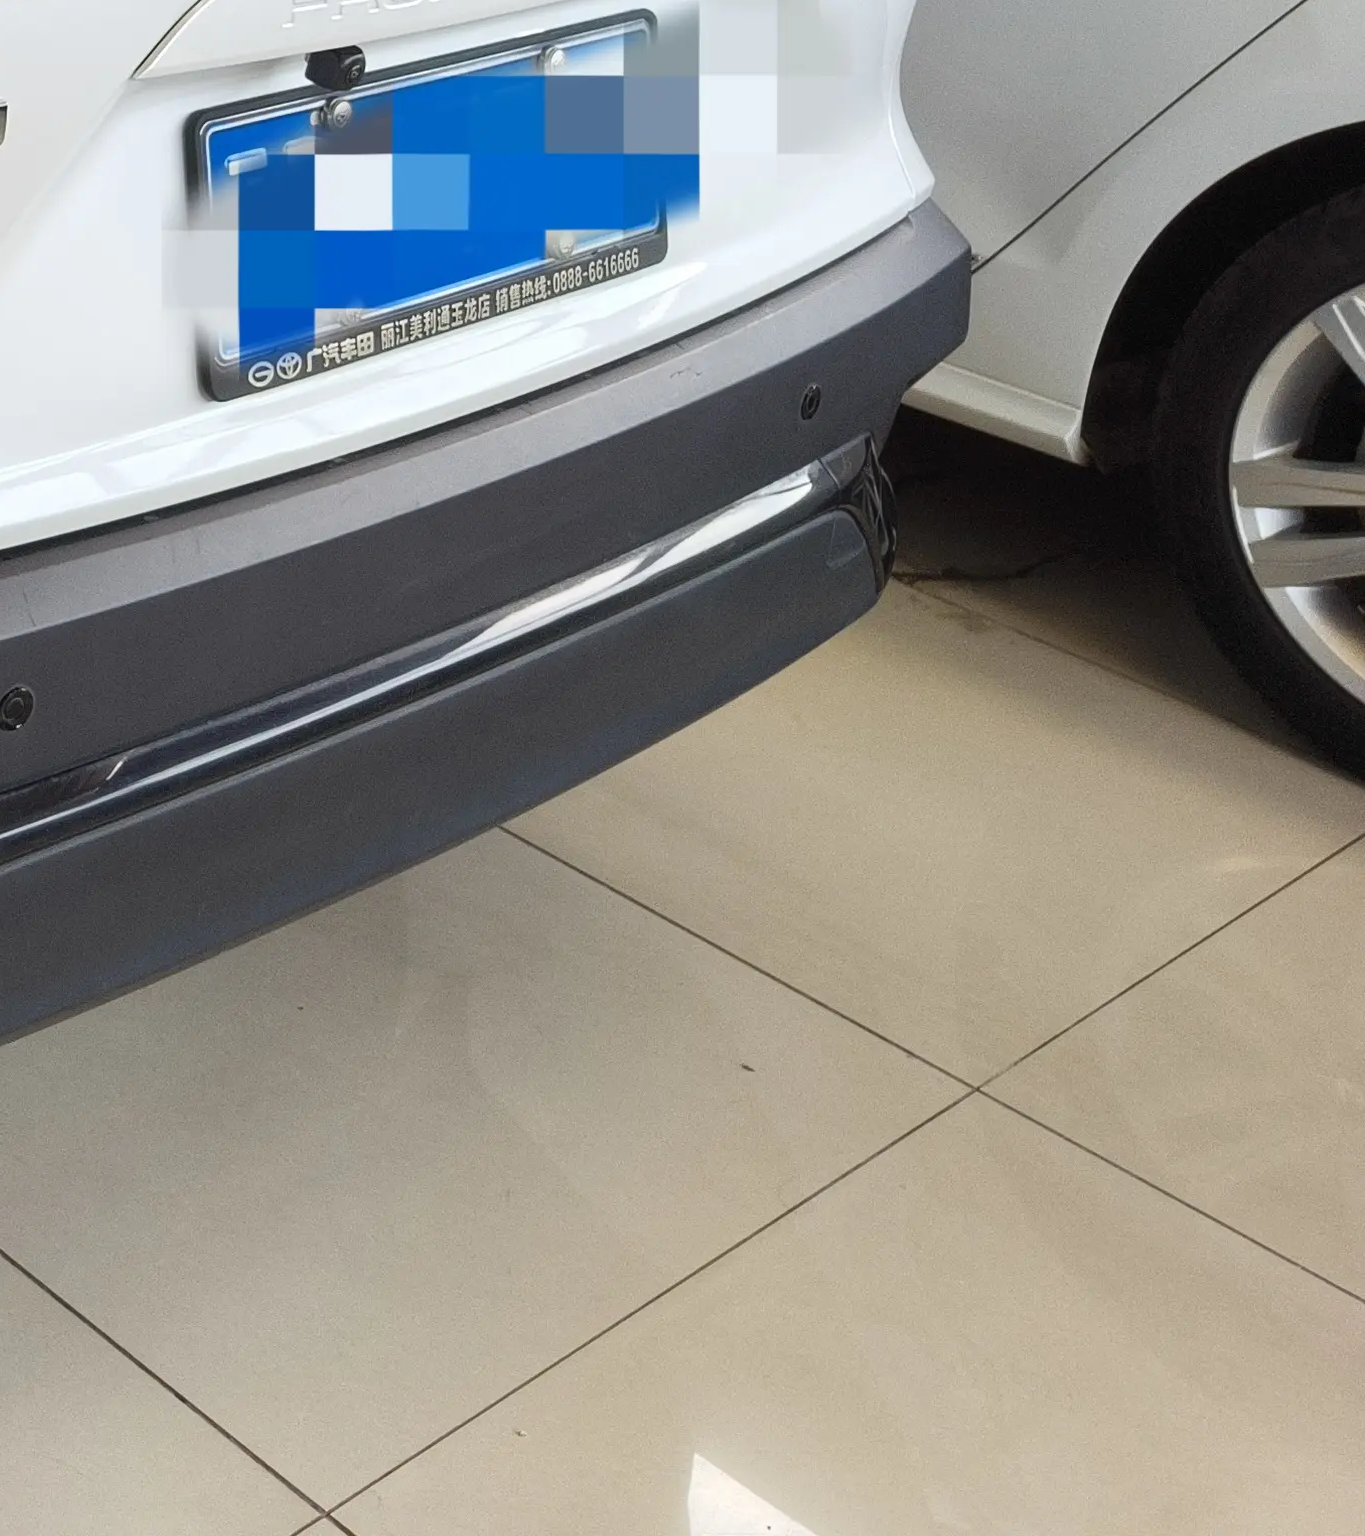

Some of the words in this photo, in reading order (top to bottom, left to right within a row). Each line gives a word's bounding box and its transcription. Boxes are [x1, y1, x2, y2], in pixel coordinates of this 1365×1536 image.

[306, 330, 374, 373] 广汽丰田
[380, 293, 491, 351] 丽江美利通玉龙店
[495, 247, 639, 313] 销售热线:0888-6616666
